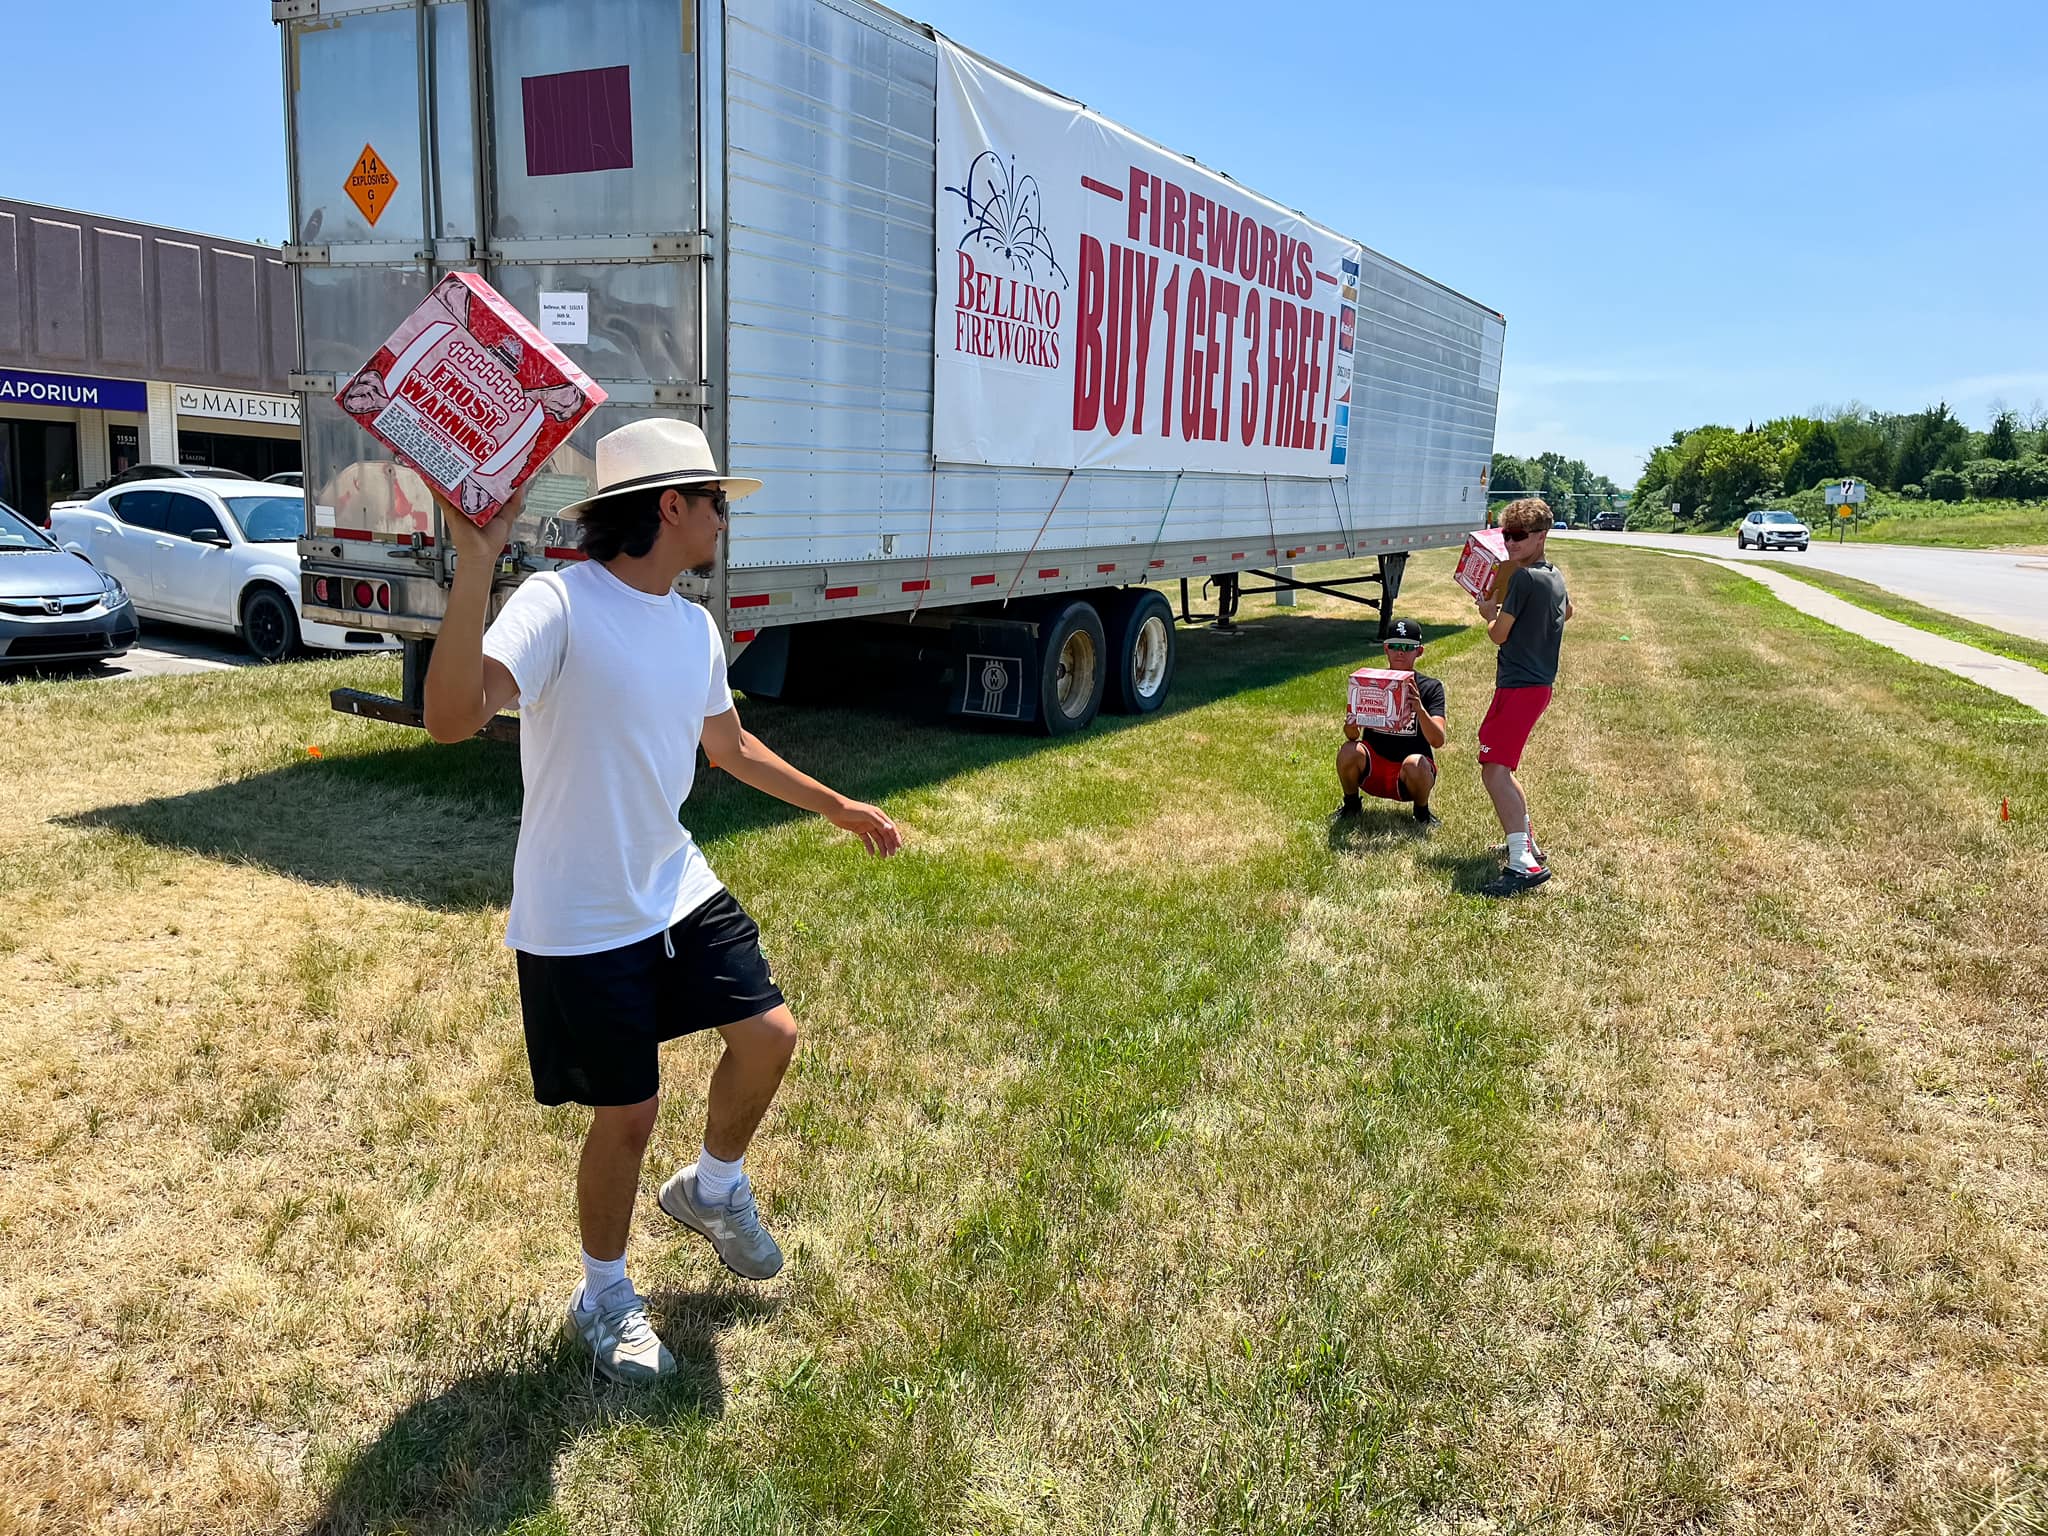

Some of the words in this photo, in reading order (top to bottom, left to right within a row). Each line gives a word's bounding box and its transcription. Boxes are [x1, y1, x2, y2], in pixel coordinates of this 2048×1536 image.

[352, 174, 390, 187] EXPLOSIVES
[361, 158, 377, 174] 1.4
[367, 189, 375, 200] G
[369, 204, 374, 214] 1
[1129, 166, 1313, 300] FIREWORKS
[955, 249, 1060, 329] BELLINO
[955, 310, 1060, 369] FIREWORKS
[1073, 234, 1158, 436] BUY
[1162, 265, 1180, 437] 1
[1181, 268, 1239, 442] GET
[1241, 288, 1261, 447] 3
[1263, 300, 1336, 451] FREE!
[0, 380, 98, 404] APORIUM
[428, 361, 508, 431] FROST
[400, 369, 498, 463] WARNING
[418, 417, 452, 448] WARNING
